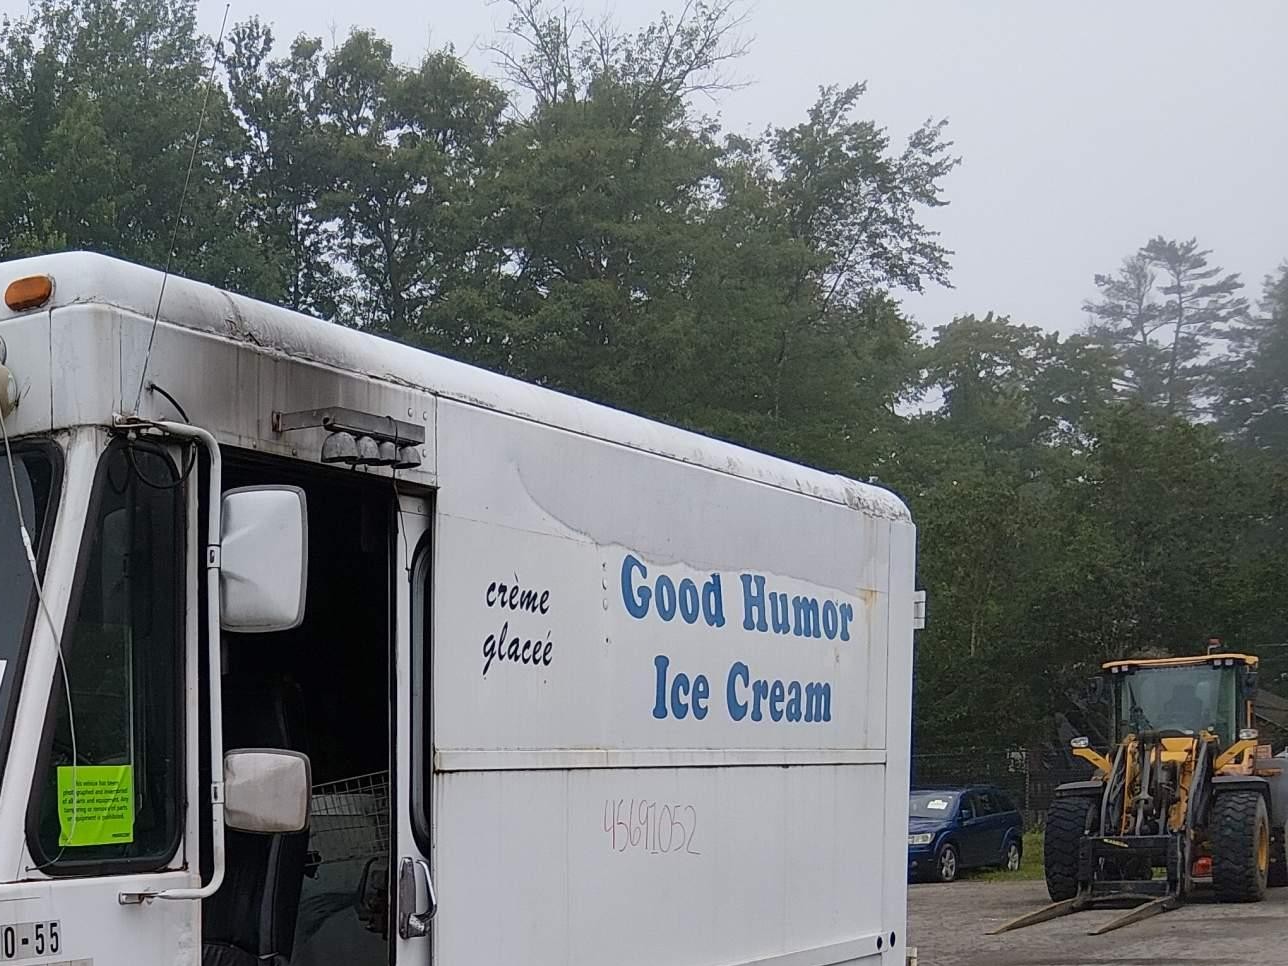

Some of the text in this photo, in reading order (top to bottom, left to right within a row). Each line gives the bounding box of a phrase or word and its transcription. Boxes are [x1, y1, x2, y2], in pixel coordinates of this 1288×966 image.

[486, 571, 550, 614] crème
[621, 554, 854, 642] Good Humor
[652, 655, 832, 723] Ice Cream
[603, 799, 701, 855] 45691052
